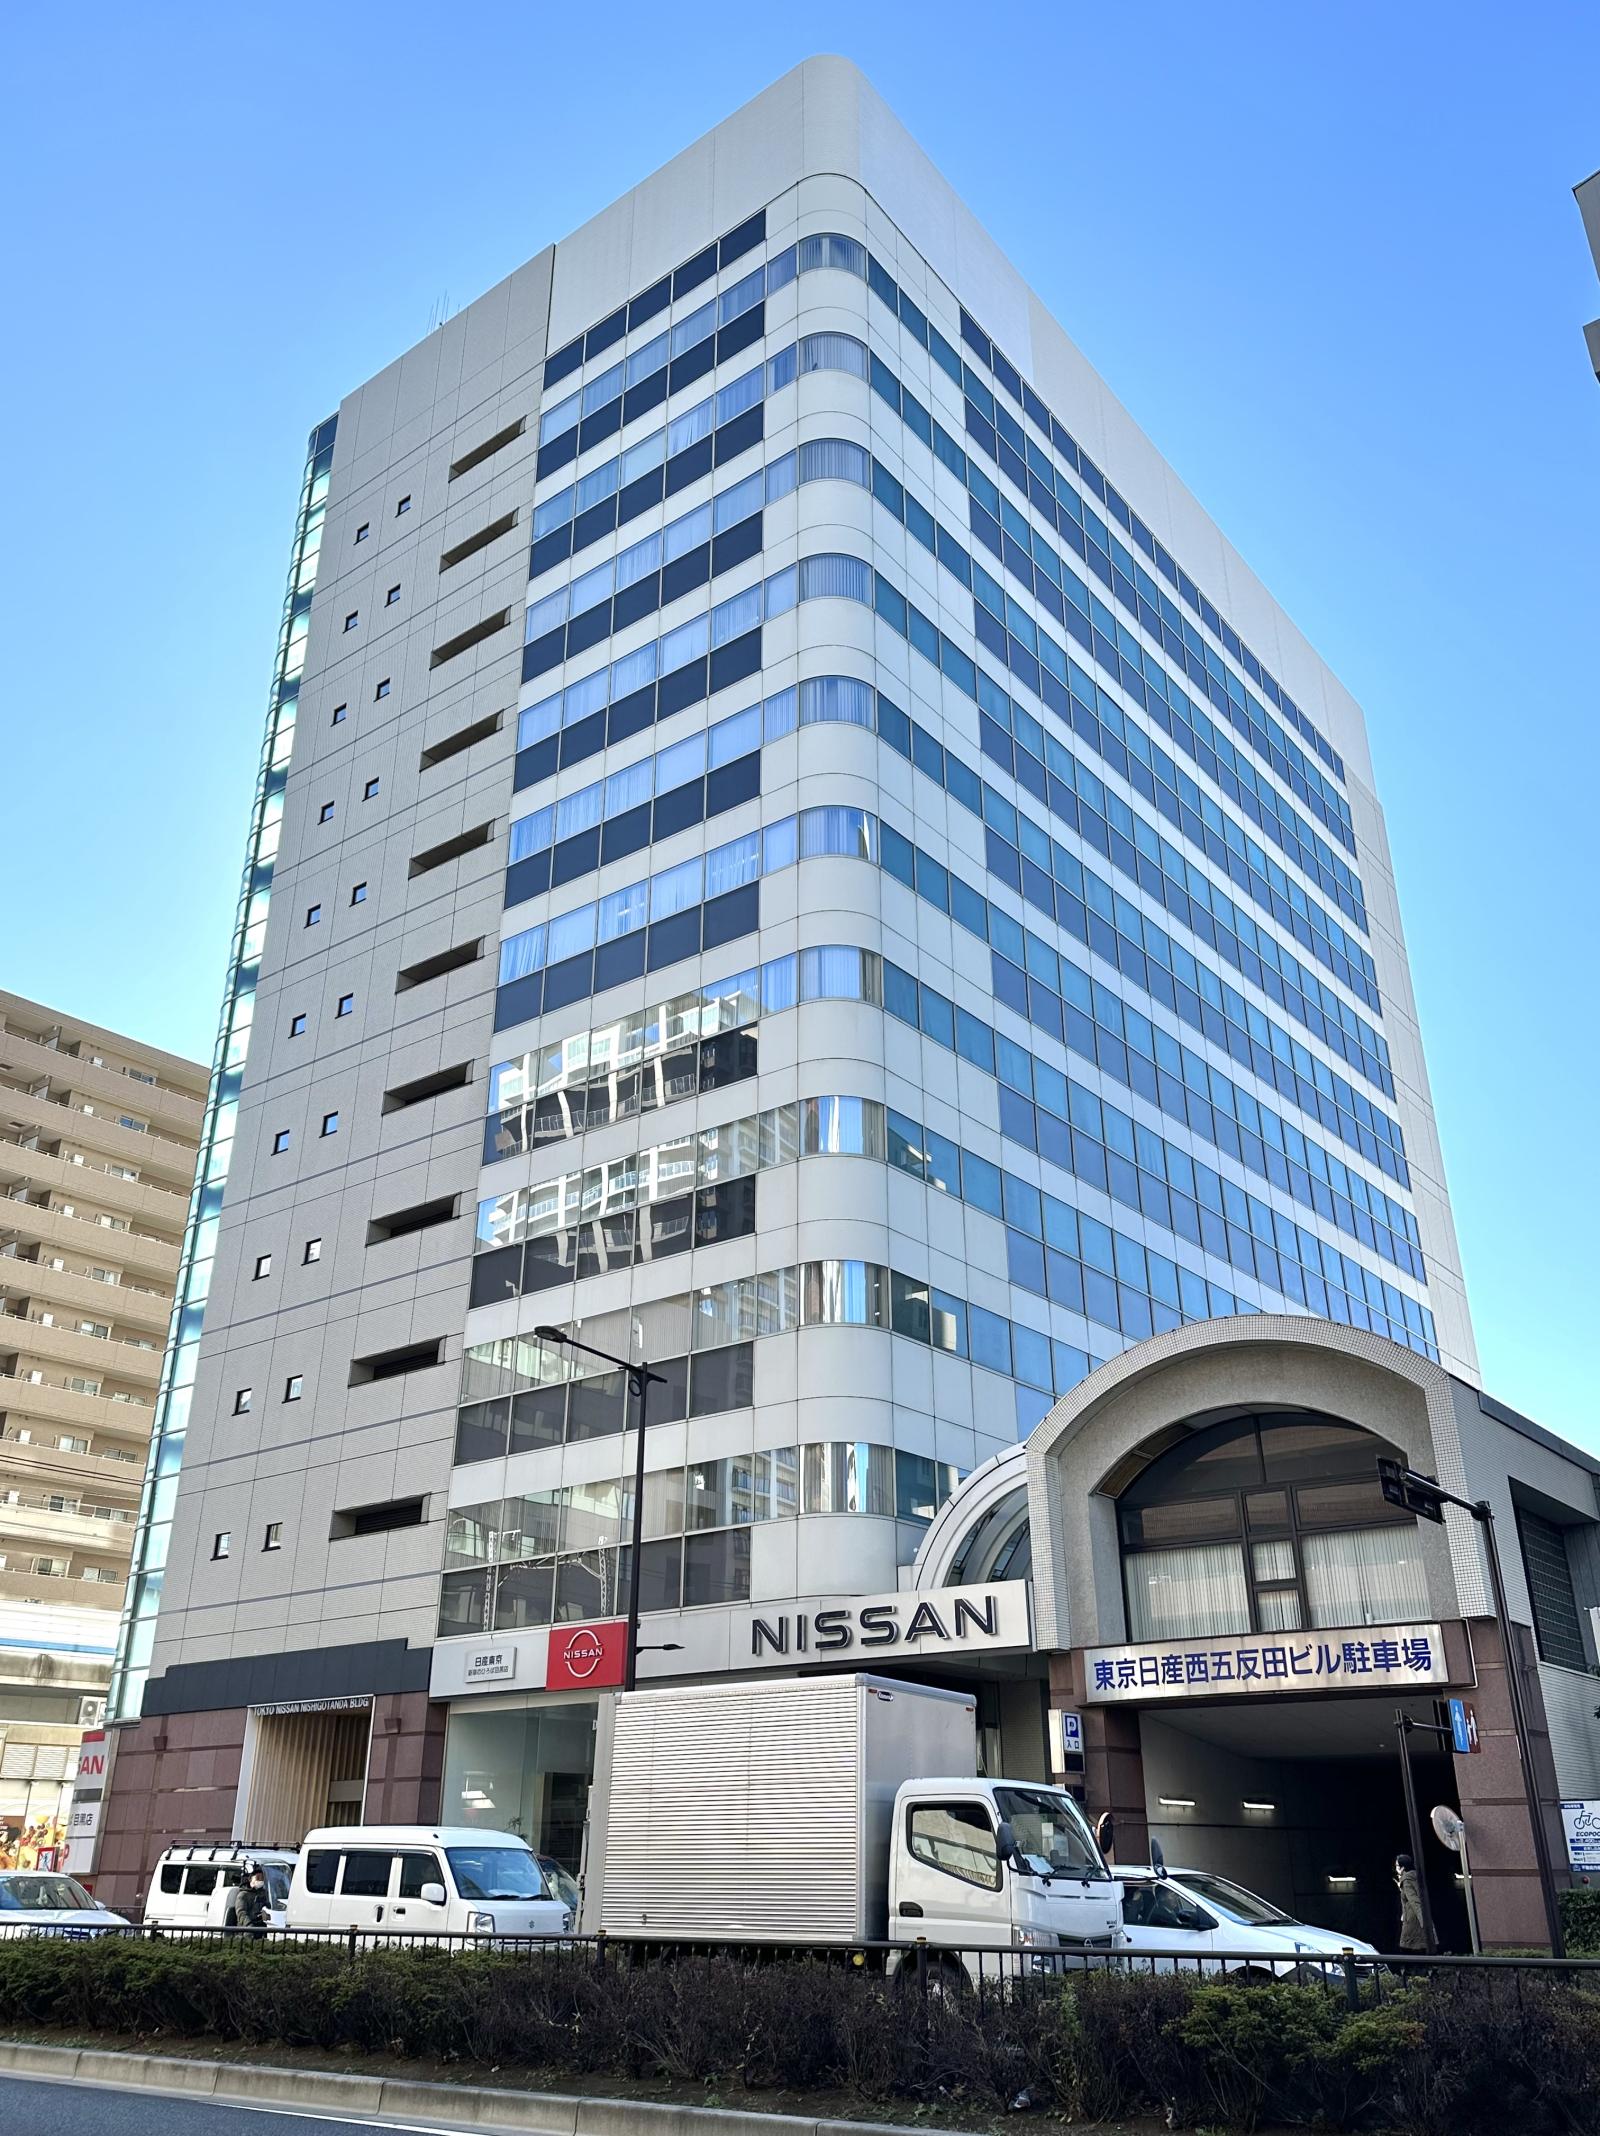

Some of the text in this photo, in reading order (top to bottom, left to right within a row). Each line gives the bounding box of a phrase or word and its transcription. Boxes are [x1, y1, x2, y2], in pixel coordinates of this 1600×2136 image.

[752, 1595, 997, 1656] NISSAN
[475, 1654, 503, 1667] 日産東京
[563, 1647, 603, 1660] NISSAN
[1093, 1637, 1432, 1691] 東京日産西五反田ビル駐車場
[255, 1706, 274, 1716] TOKYO
[275, 1704, 299, 1715] NISSAN
[300, 1699, 348, 1713] NISHIGOTANDA
[1066, 1717, 1078, 1736] P
[1067, 1739, 1080, 1750] 入口
